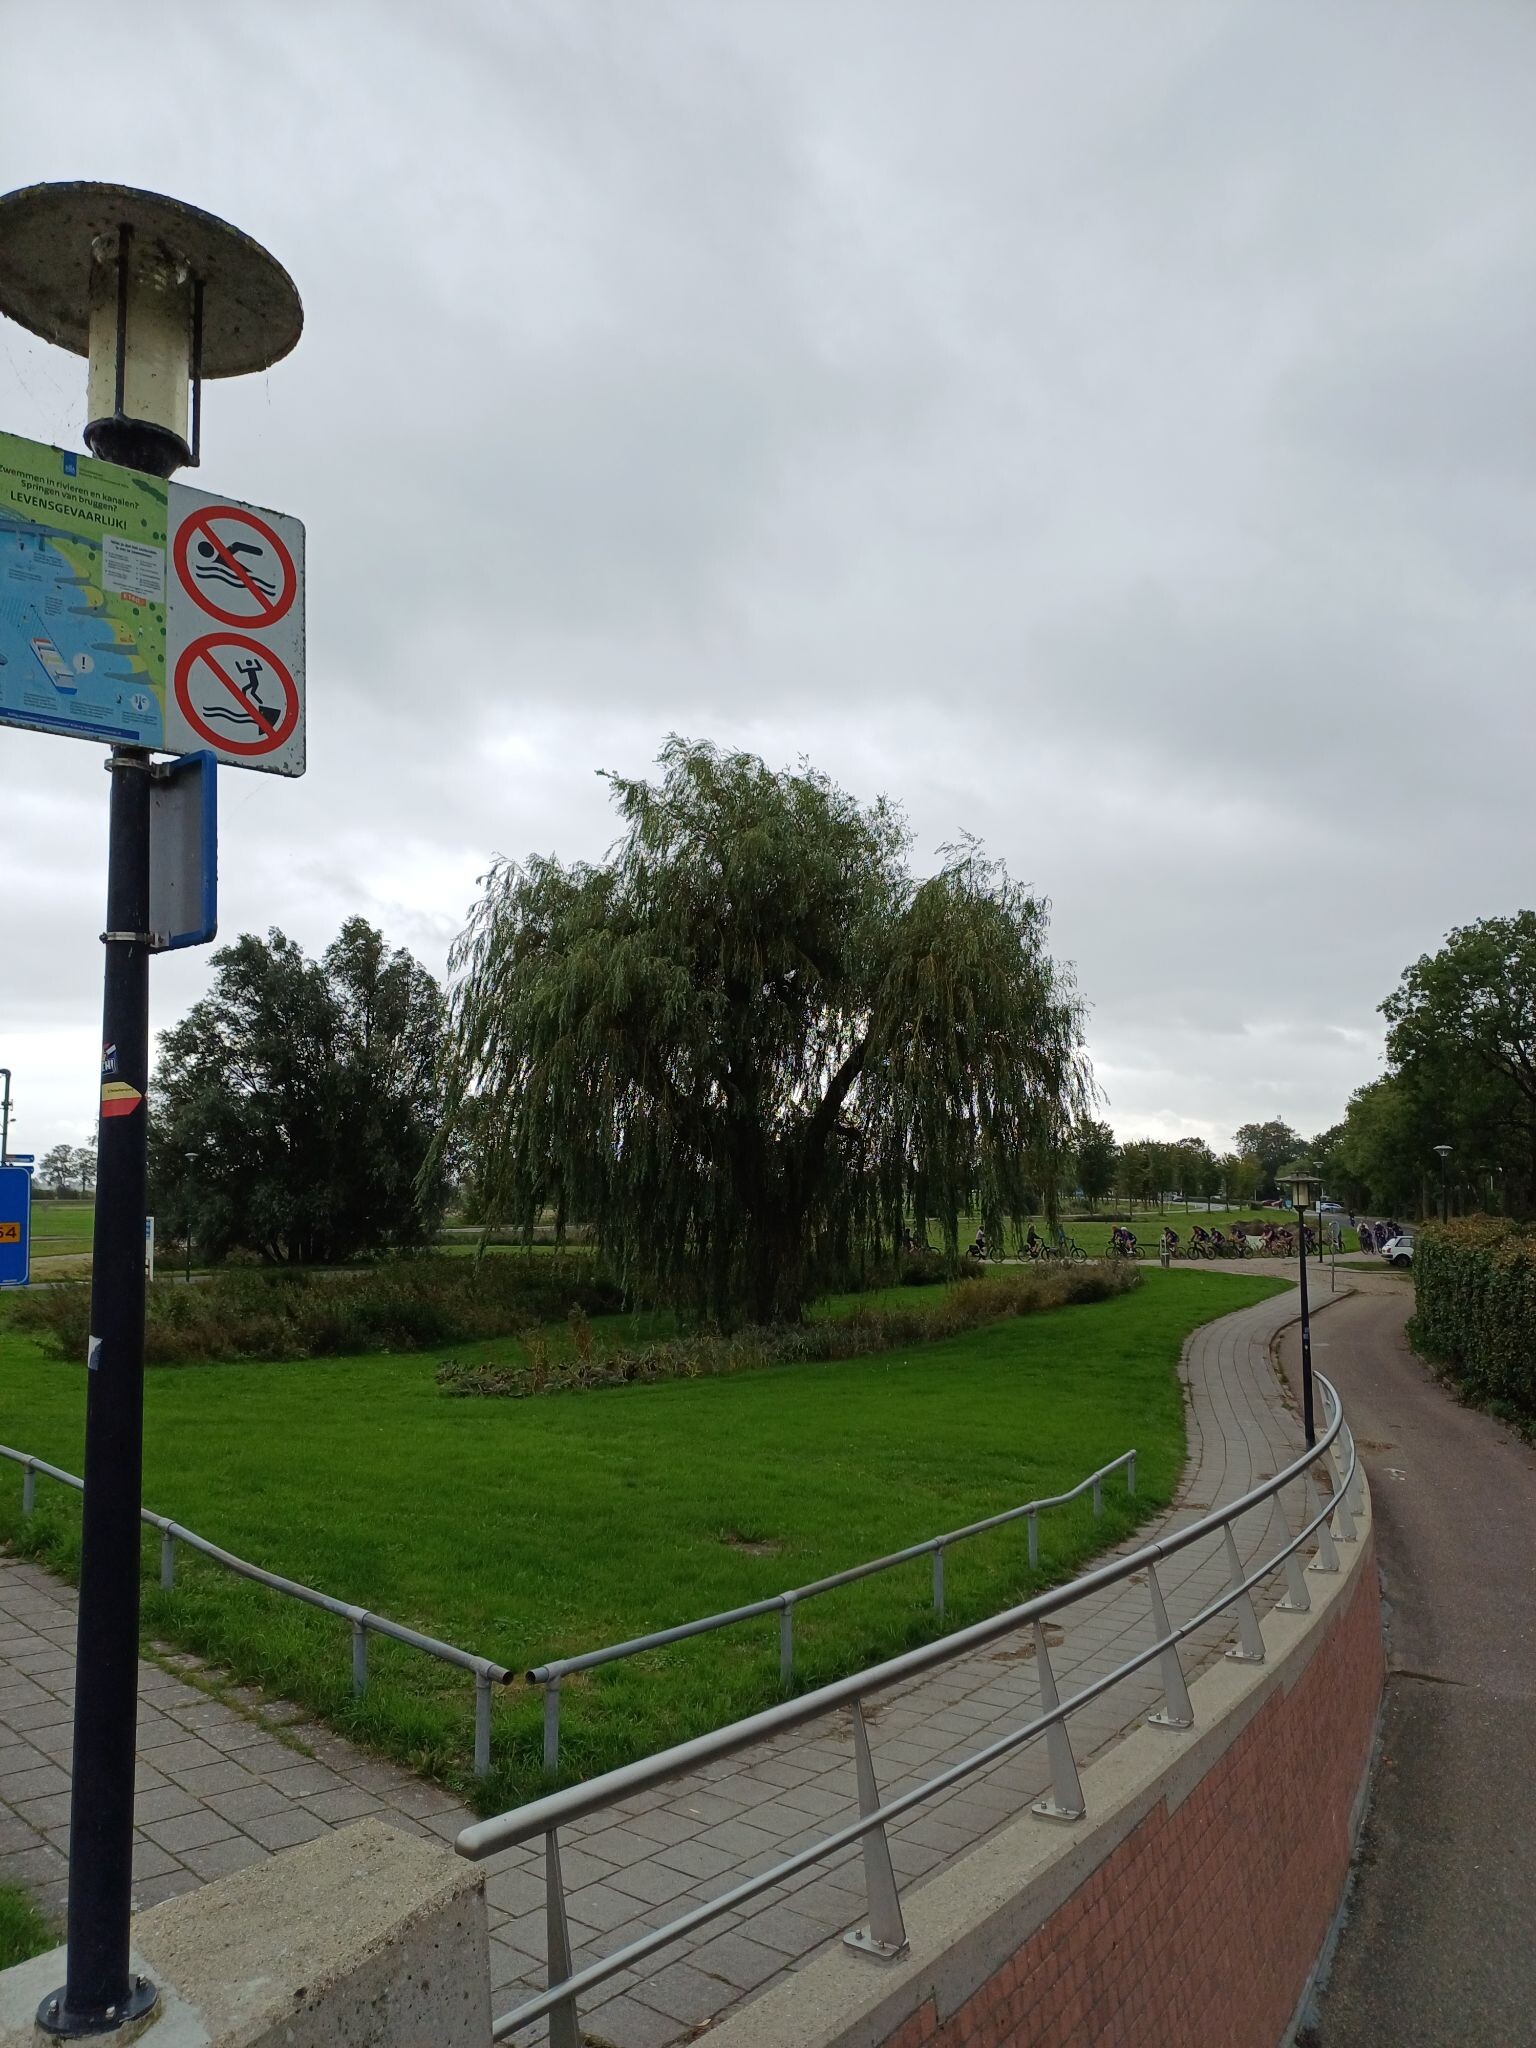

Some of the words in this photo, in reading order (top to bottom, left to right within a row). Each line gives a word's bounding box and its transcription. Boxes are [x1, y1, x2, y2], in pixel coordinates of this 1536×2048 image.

[21, 479, 60, 497] Springen
[61, 492, 77, 502] van
[79, 495, 118, 513] bruggen?
[46, 477, 55, 486] in
[56, 479, 89, 497] rivieren
[90, 491, 101, 499] en
[102, 492, 140, 510] kanalen?
